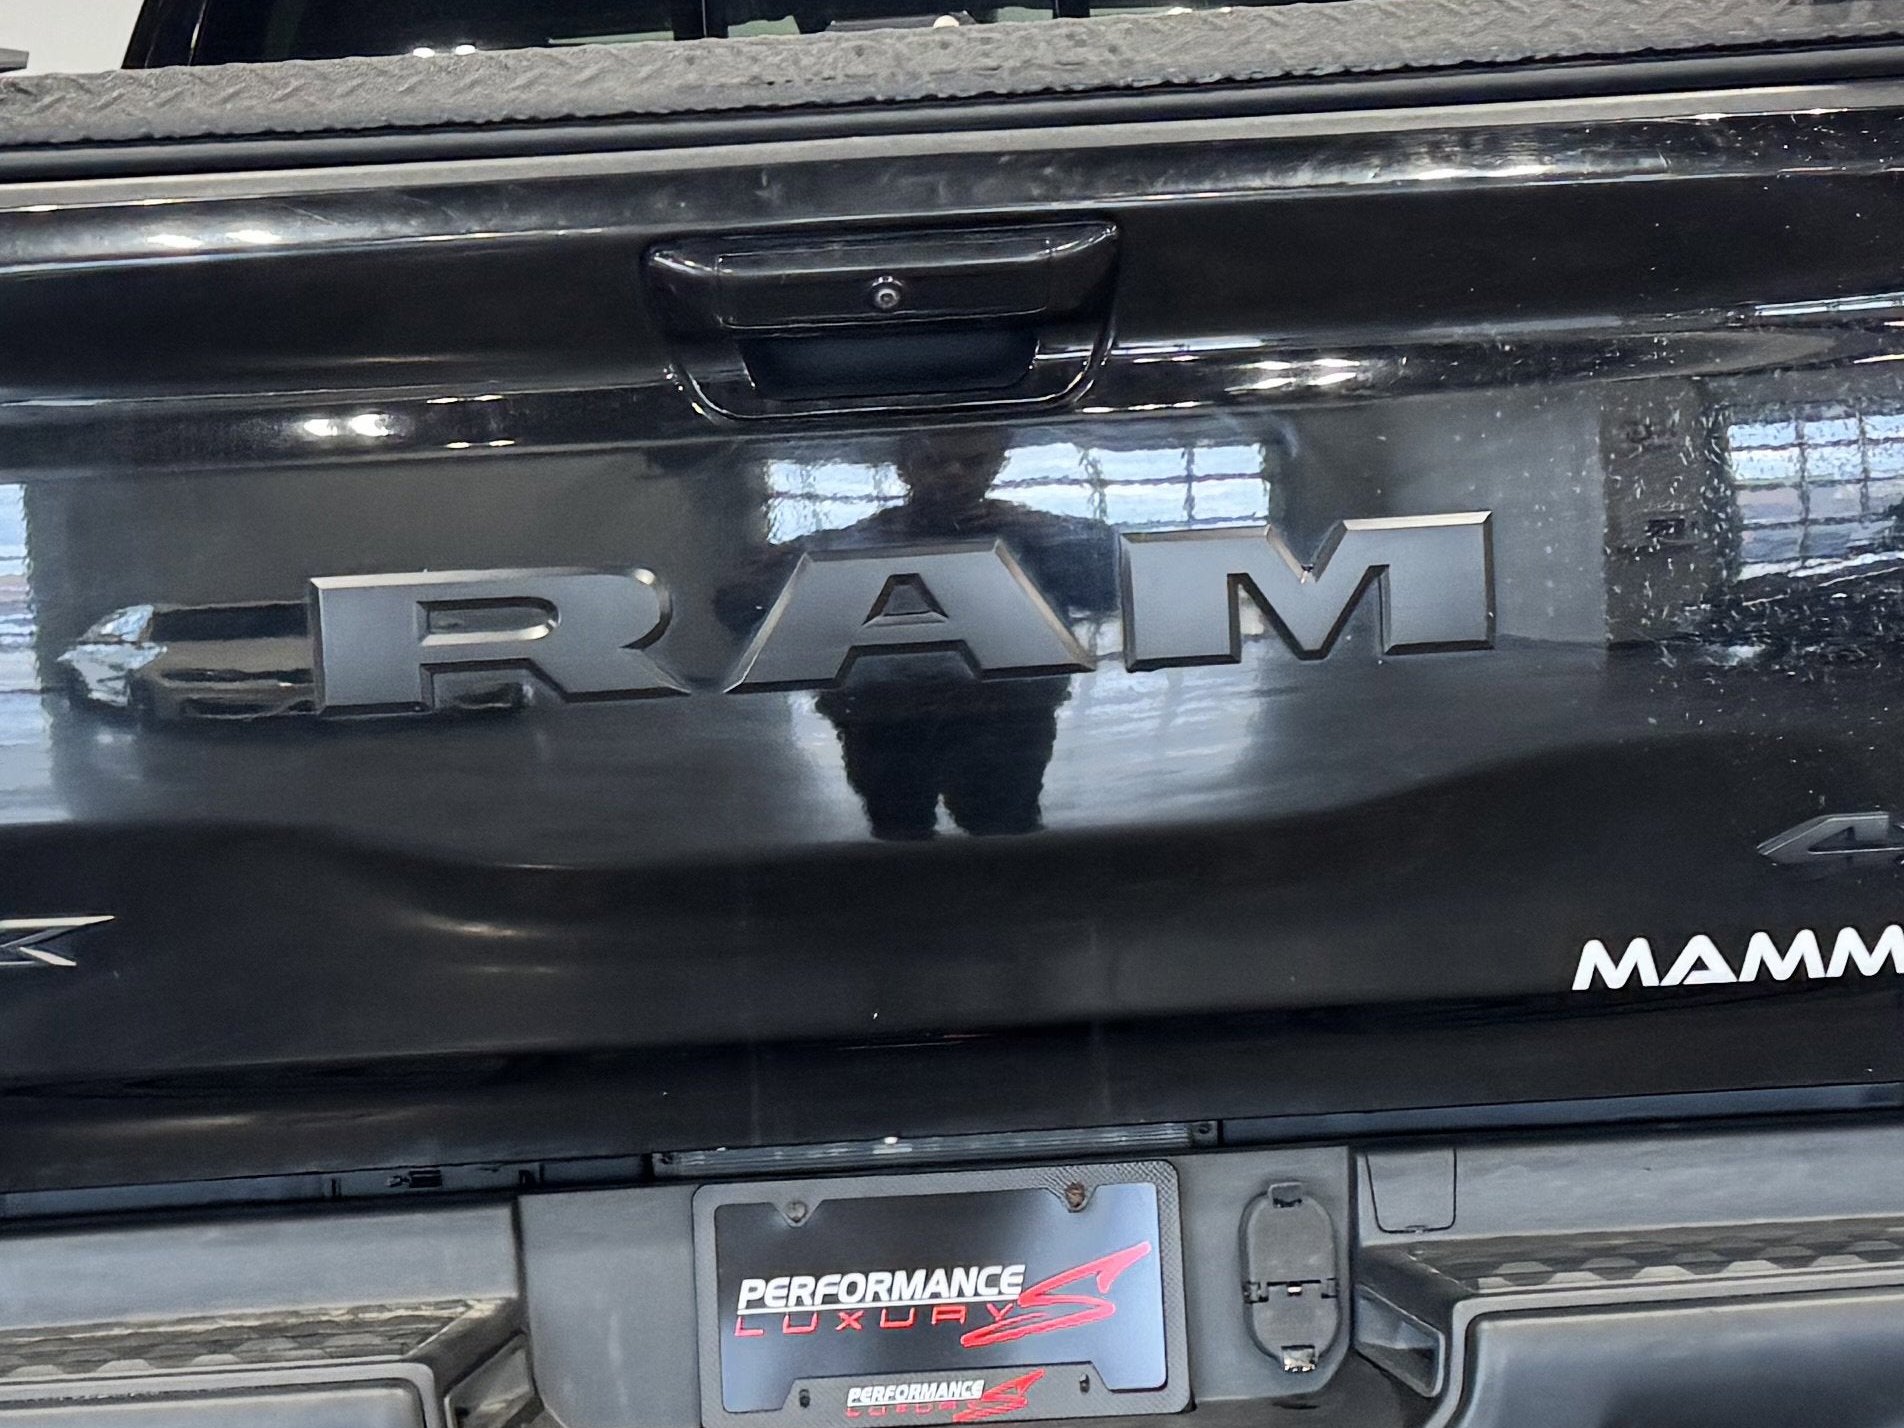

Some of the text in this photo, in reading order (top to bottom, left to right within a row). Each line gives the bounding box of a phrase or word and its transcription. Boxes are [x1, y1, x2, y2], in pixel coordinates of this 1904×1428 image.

[310, 511, 1496, 717] RAM
[738, 1264, 1026, 1309] PERFORMANCE
[734, 1302, 1015, 1336] LUXURY
[847, 1380, 985, 1407] PERFORMANCE
